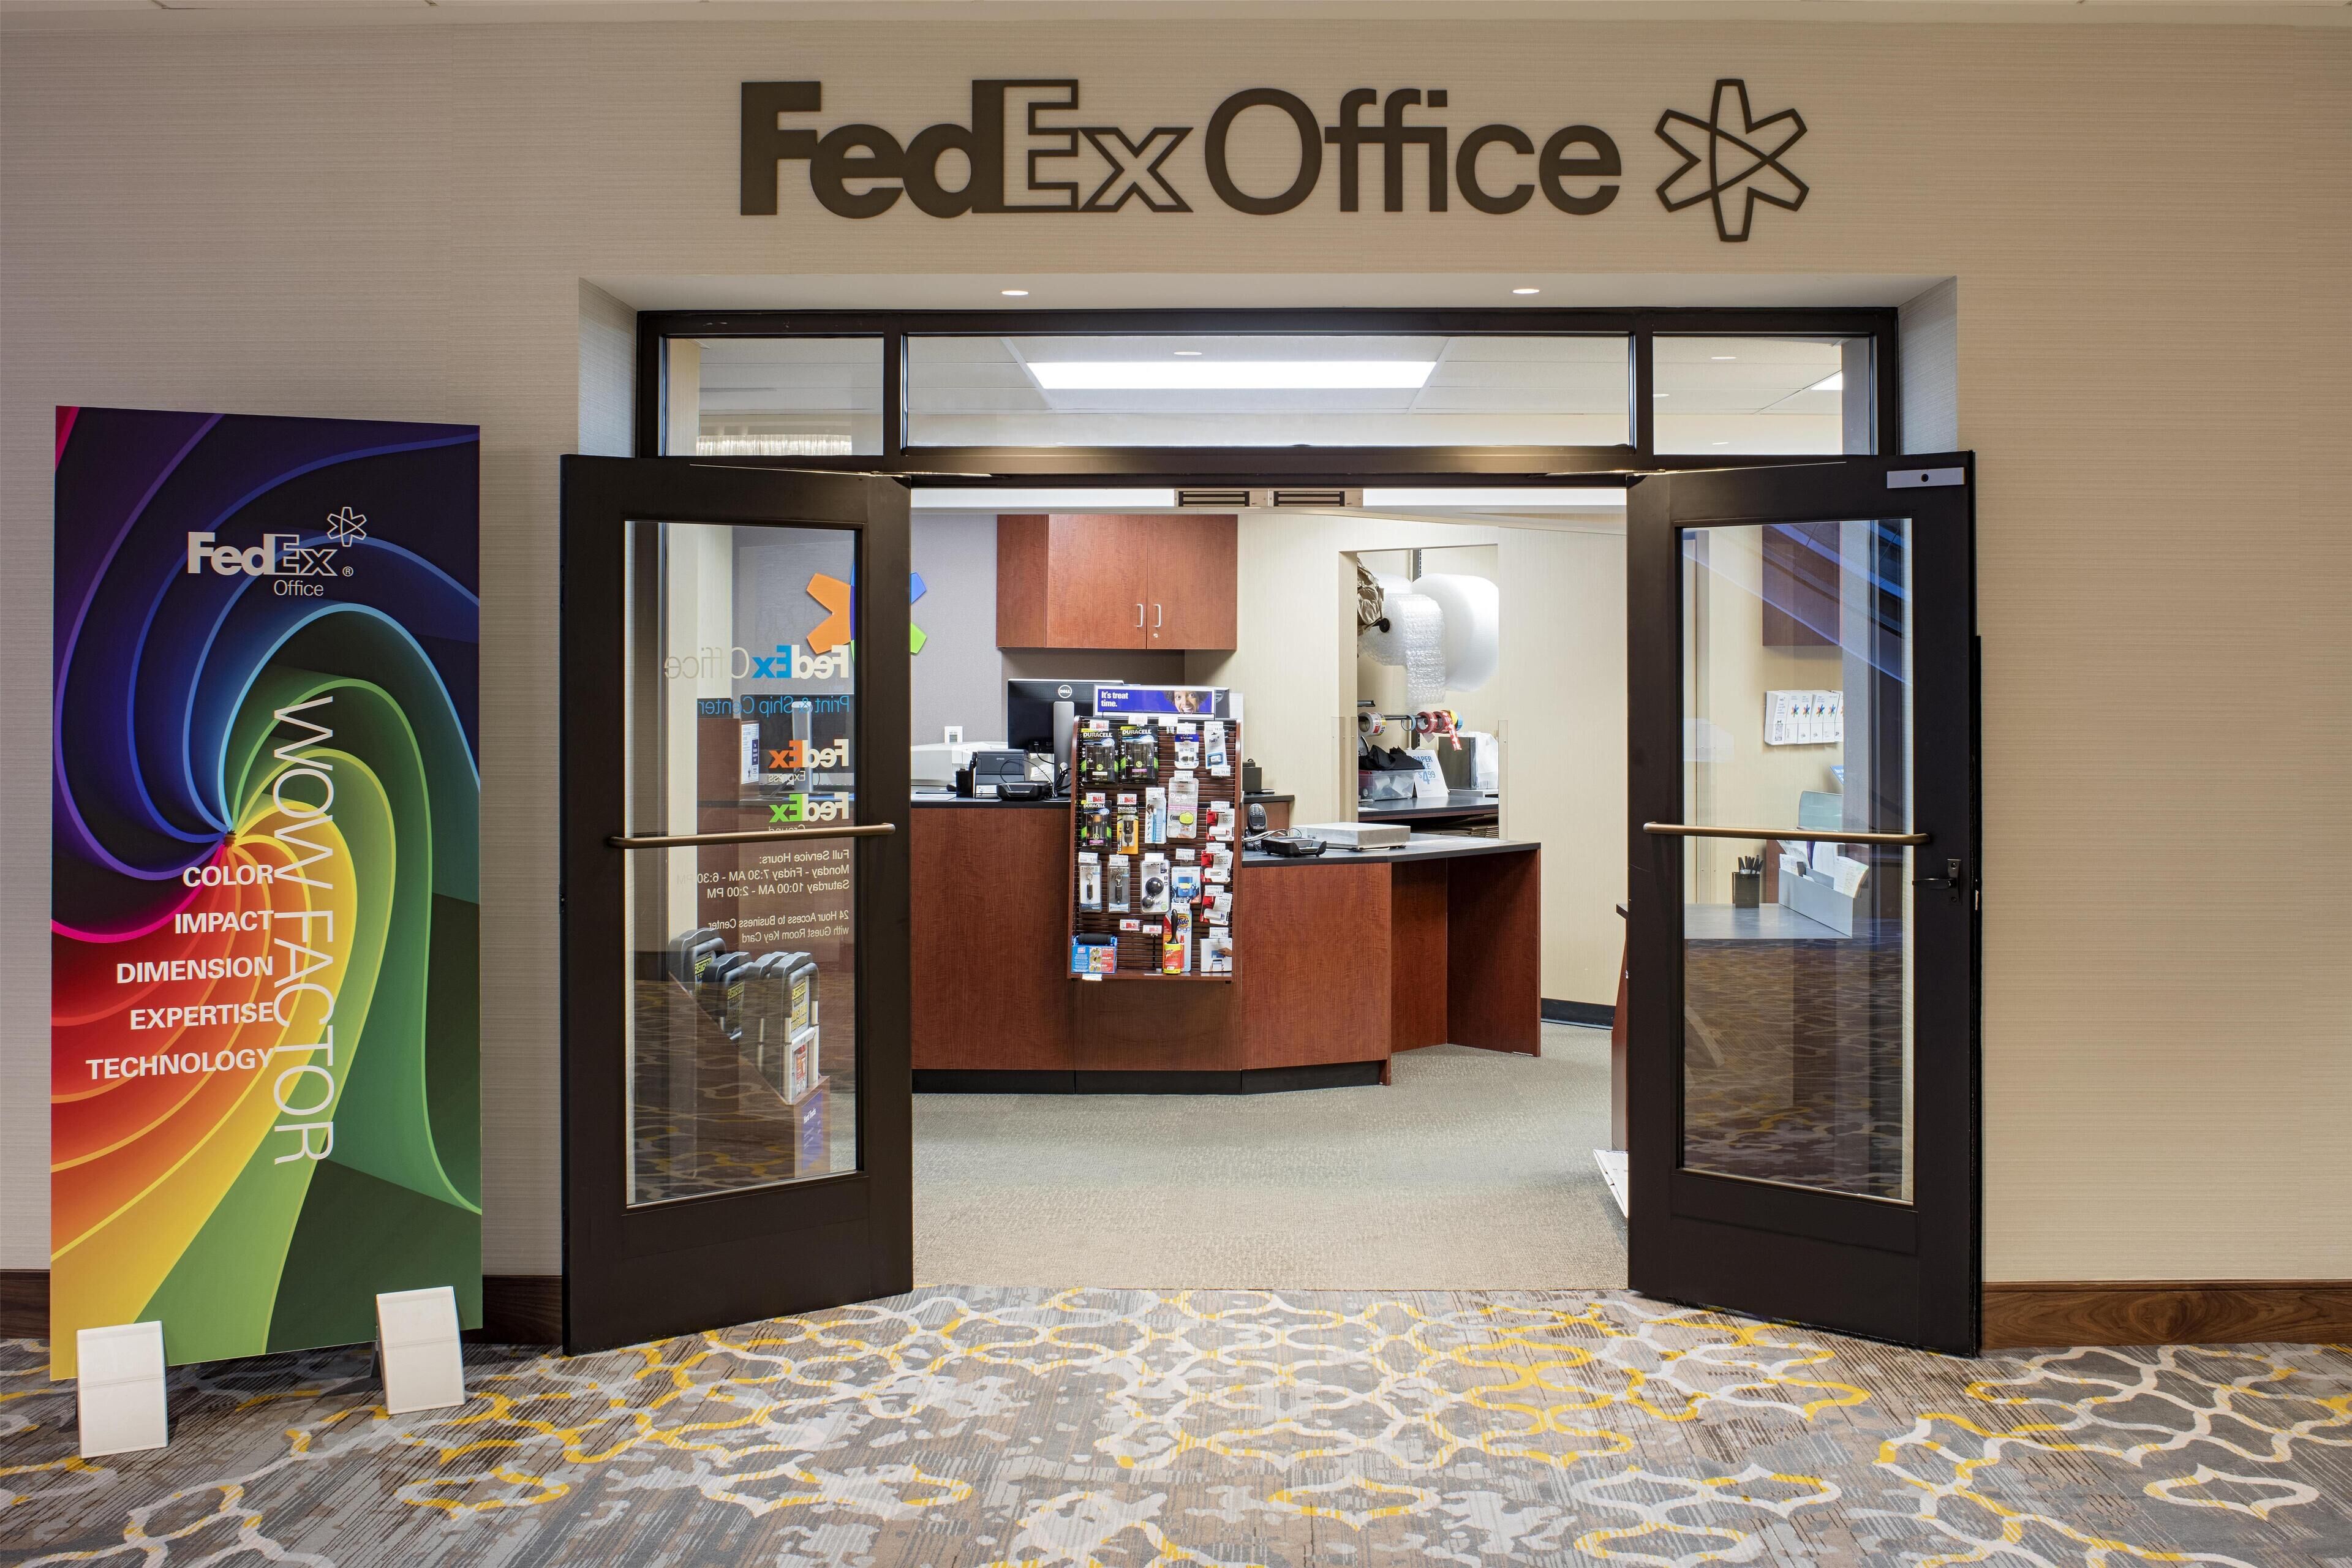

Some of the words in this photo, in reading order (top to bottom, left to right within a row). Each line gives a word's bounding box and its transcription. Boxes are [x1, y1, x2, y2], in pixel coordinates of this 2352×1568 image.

[740, 78, 1194, 219] FedEx
[1204, 87, 1623, 216] Office
[187, 531, 339, 576] FedEx
[273, 579, 324, 597] Office
[1101, 691, 1112, 699] It's
[1112, 692, 1129, 700] treat
[273, 696, 334, 890] WOW
[183, 864, 274, 888] COLOR
[175, 910, 274, 935] IMPACT
[116, 956, 274, 984] DIMENSION
[130, 1001, 274, 1031] EXPERTISE
[273, 910, 335, 1166] FACTOR
[86, 1048, 274, 1080] TECHNOLOGY
